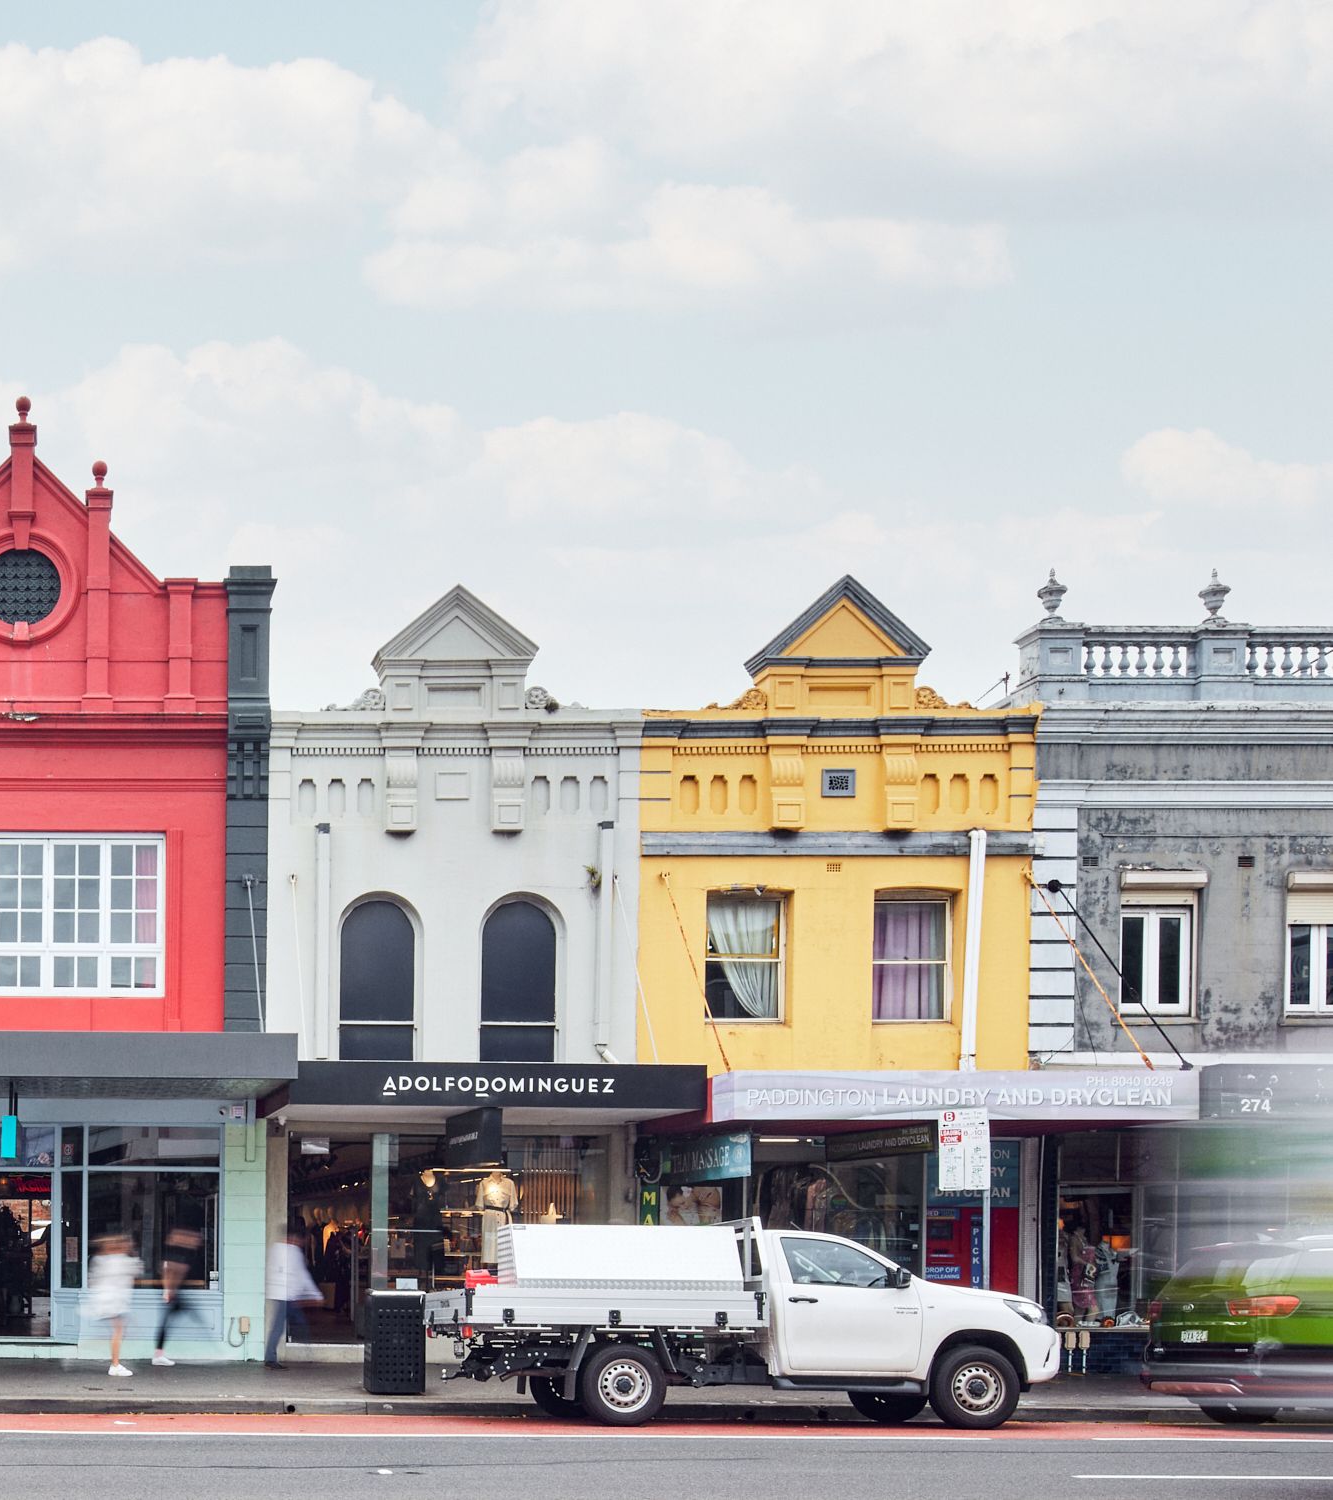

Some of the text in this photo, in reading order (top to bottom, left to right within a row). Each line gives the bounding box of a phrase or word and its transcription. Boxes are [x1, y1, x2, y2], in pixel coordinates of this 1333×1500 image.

[1086, 1076, 1173, 1087] PH: 8040 0249
[747, 1088, 1173, 1107] PADDINGTON LAUNDRY AND DRYCLEAN
[1241, 1098, 1272, 1113] 274
[858, 1140, 884, 1151] LAUNDRY
[885, 1137, 896, 1147] AND
[898, 1133, 930, 1146] DRYCLEAN
[935, 1187, 1011, 1198] DRYCLAN
